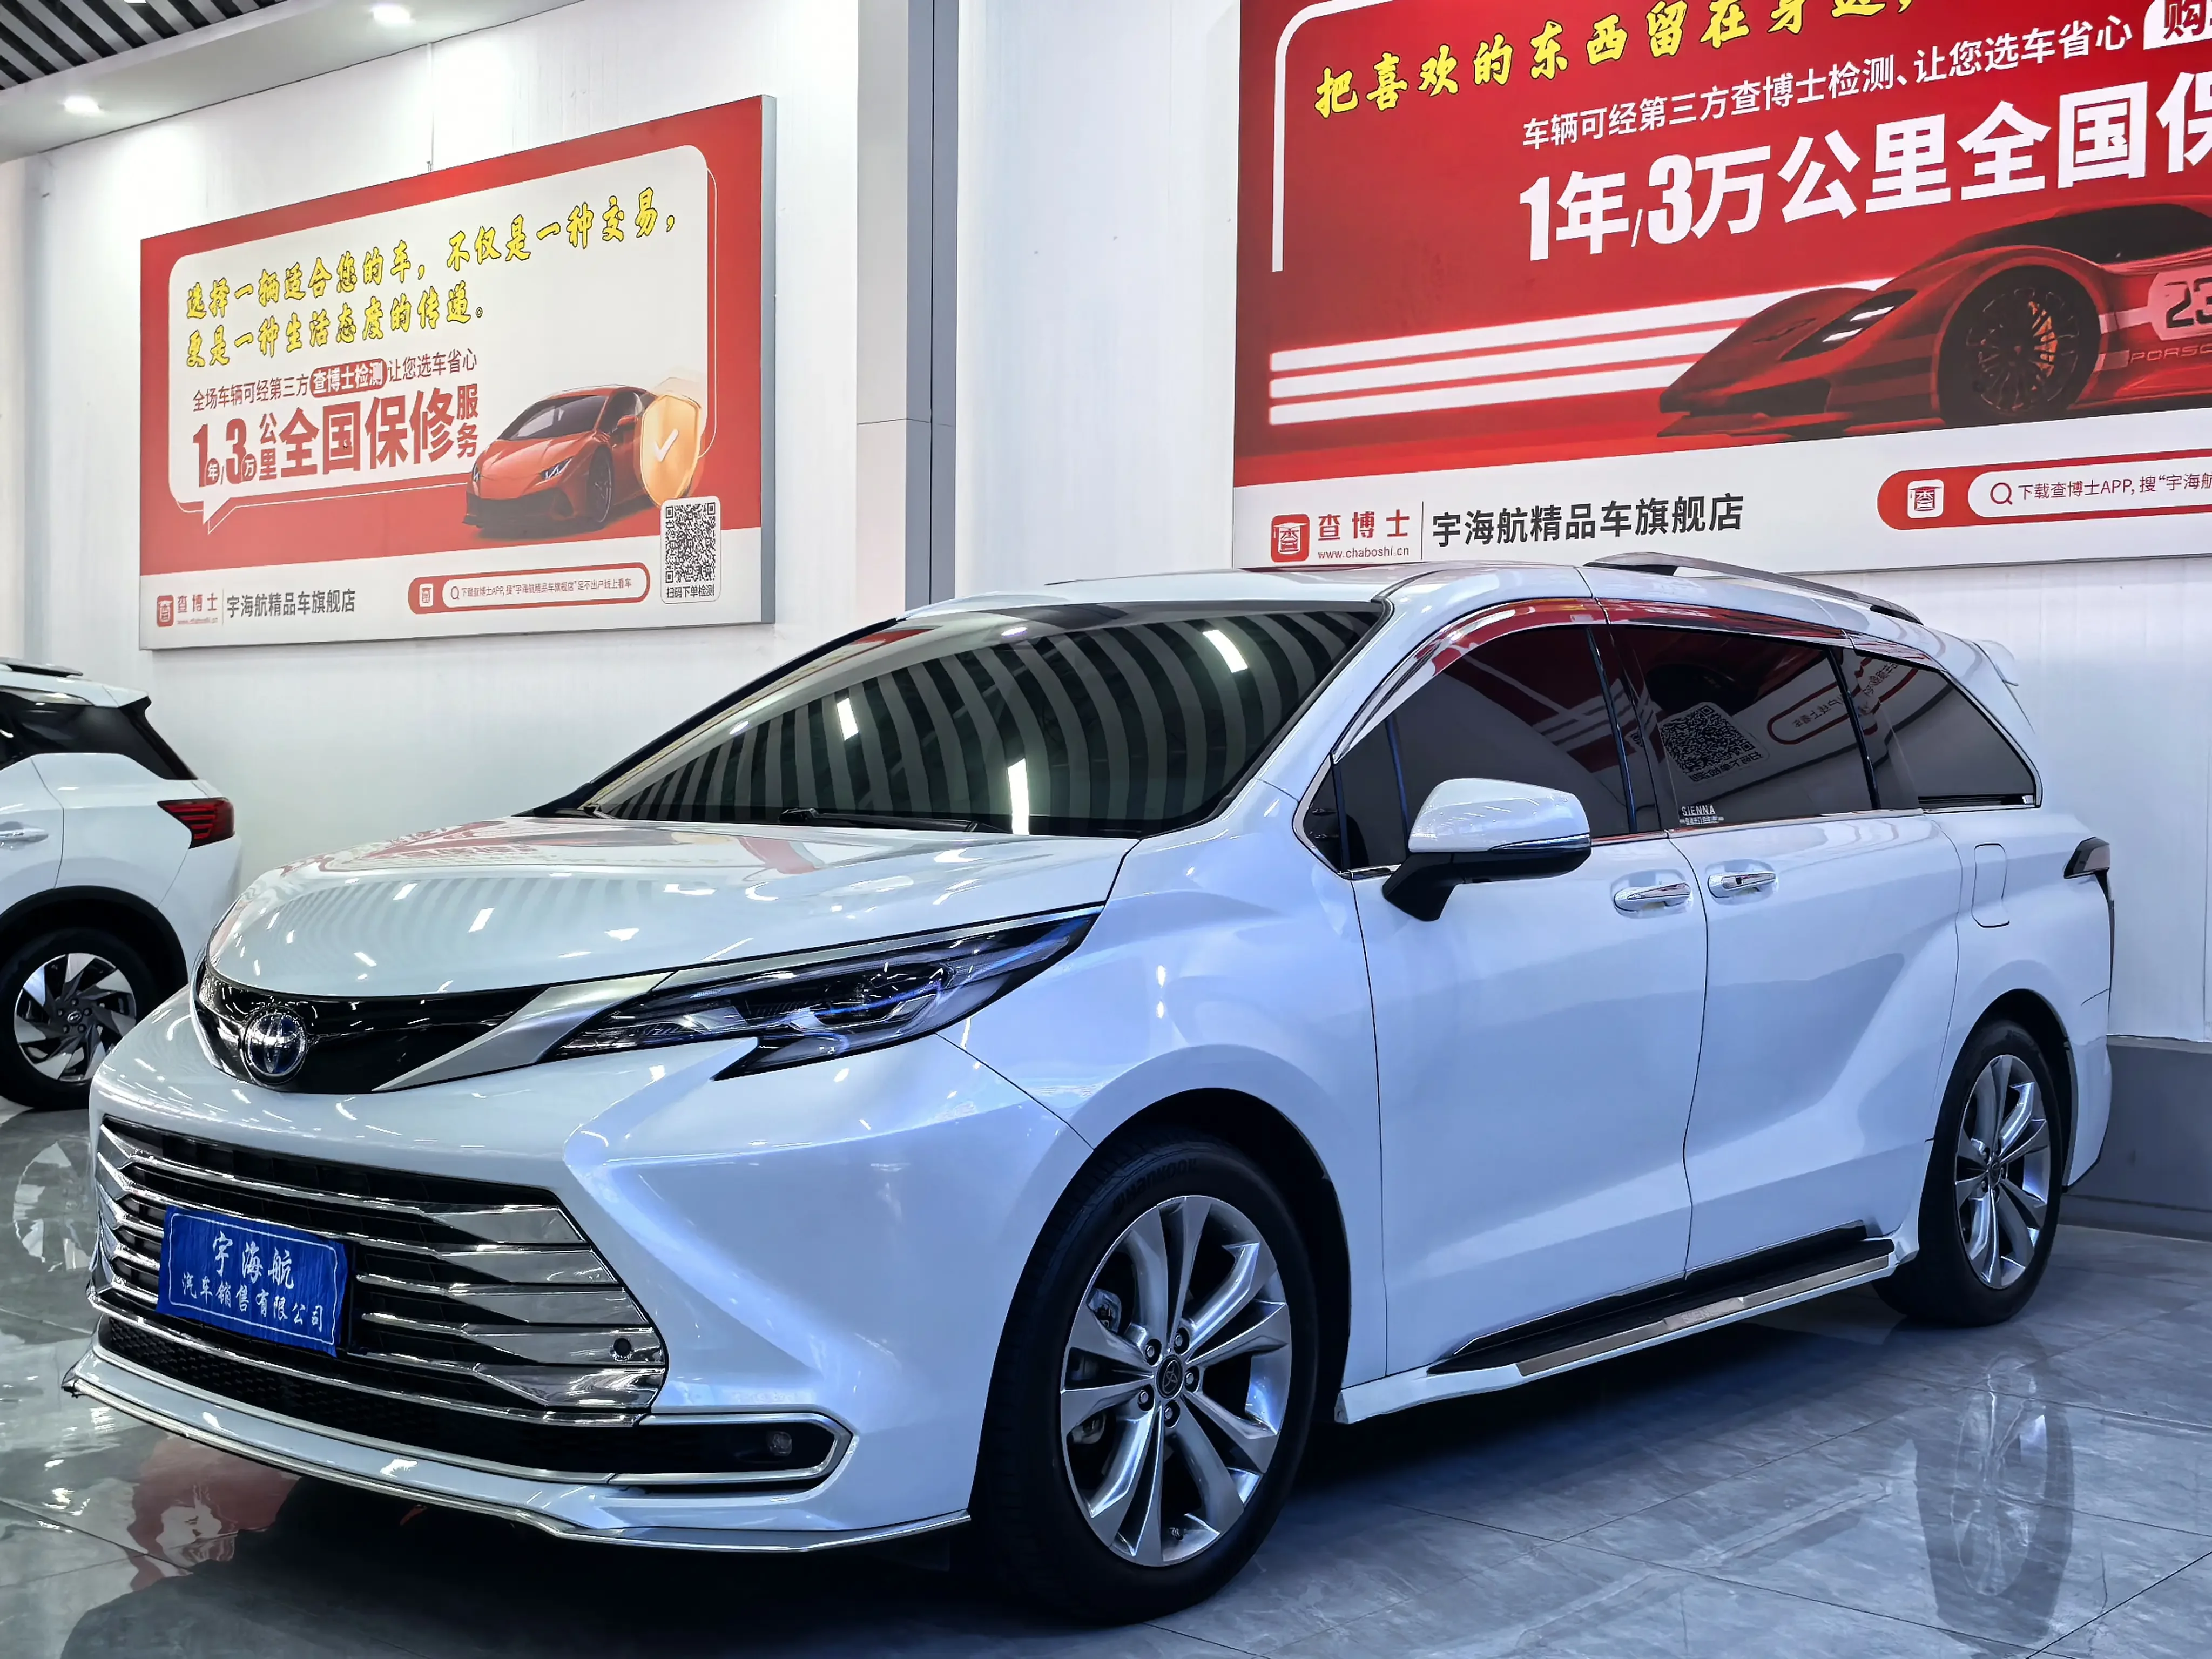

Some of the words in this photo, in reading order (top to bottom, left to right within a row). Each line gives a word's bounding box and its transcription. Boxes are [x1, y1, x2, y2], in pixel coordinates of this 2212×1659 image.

[1314, 0, 1913, 118] 把喜欢的东西留在身，
[1318, 509, 1410, 541] 查博士
[1432, 493, 1745, 548] 宇海航精品车旗舰店
[1318, 544, 1410, 559] www.chaboshi.cn
[666, 584, 714, 598] 扫码下单检测
[1681, 804, 1716, 817] SIENNA
[212, 1231, 294, 1290] 宇海航
[181, 1272, 324, 1333] 汽车销售有限公司
